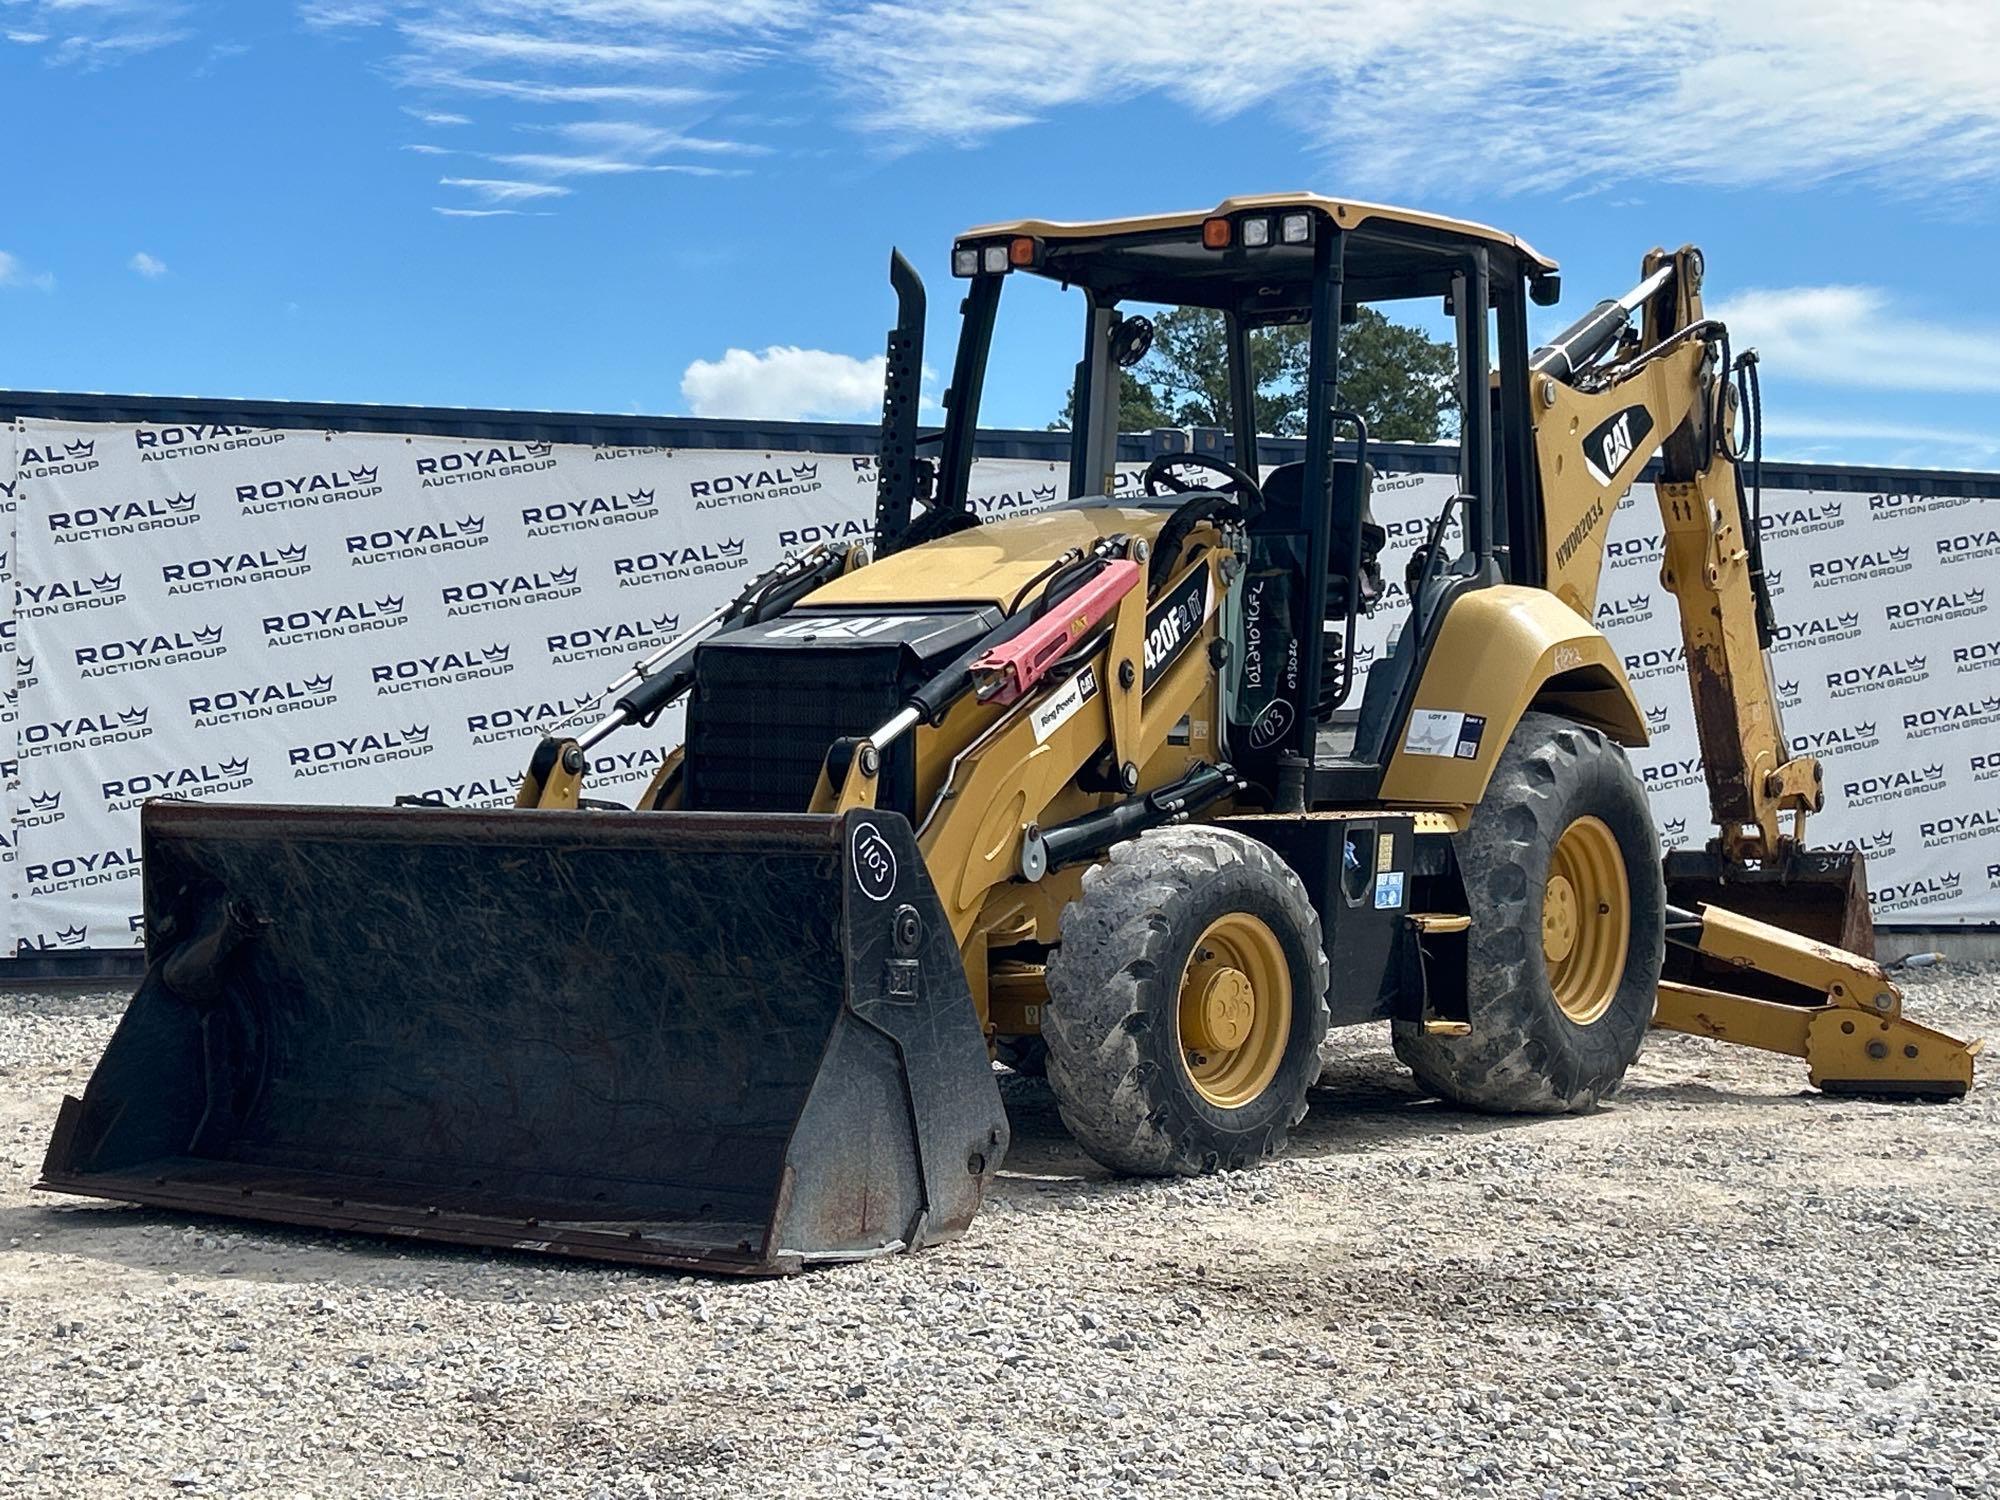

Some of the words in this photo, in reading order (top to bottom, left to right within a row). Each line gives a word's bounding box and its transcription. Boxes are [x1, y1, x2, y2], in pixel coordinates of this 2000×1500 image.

[141, 443, 220, 462] AUCTION
[223, 433, 285, 450] GROUP
[1603, 412, 1632, 474] CAT
[35, 460, 100, 478] GROUP
[416, 446, 526, 474] ROYAL
[421, 468, 496, 488] AUCTION
[500, 459, 557, 477] GROUP
[235, 472, 350, 503] ROYAL
[690, 468, 793, 498] ROYAL
[695, 491, 764, 510] AUCTION
[768, 482, 822, 499] GROUP
[1377, 477, 1424, 492] GROUP
[48, 499, 166, 531] ROYAL
[241, 497, 319, 516] AUCTION
[322, 486, 383, 504] GROUP
[522, 495, 628, 525] ROYAL
[1872, 506, 1926, 521] AUCTION
[54, 525, 134, 544] AUCTION
[138, 514, 200, 532] GROUP
[527, 518, 599, 538] AUCTION
[602, 508, 659, 526] GROUP
[1759, 508, 1821, 530] OYAL
[1761, 528, 1799, 542] CTION
[1801, 519, 1845, 534] GROUP
[346, 523, 457, 553] ROYAL
[351, 545, 426, 567] AUCTION
[430, 536, 489, 554] GROUP
[1936, 531, 2000, 555] ROYA
[162, 551, 278, 582] ROYAL
[614, 545, 718, 575] ROYAL
[1809, 552, 1890, 578] ROYAL
[1940, 549, 1993, 565] AUCTION
[167, 575, 247, 596] AUCTION
[250, 564, 312, 582] GROUP
[619, 568, 690, 588] AUCTION
[693, 559, 748, 576] GROUP
[1813, 571, 1868, 589] AUCTION
[1869, 563, 1913, 578] GROUP
[15, 580, 92, 605] YAL
[442, 573, 551, 604] ROYAL
[447, 597, 522, 618] AUCTION
[524, 586, 582, 604] GROUP
[16, 605, 59, 619] TION
[62, 594, 127, 613] GROUP
[262, 602, 377, 635] ROYAL
[1608, 612, 1652, 628] GROUP
[1885, 594, 1965, 620] ROYAL
[1889, 613, 1943, 631] AUCTION
[1945, 605, 1989, 620] GROUP
[267, 626, 345, 648] AUCTION
[348, 616, 408, 634] GROUP
[547, 621, 653, 652] ROYAL
[765, 616, 927, 637] CAT
[1776, 618, 1838, 641] OYAL
[1818, 629, 1862, 645] GROUP
[75, 632, 193, 666] ROYAL
[80, 657, 161, 679] AUCTION
[164, 646, 227, 664] GROUP
[552, 645, 624, 665] AUCTION
[1953, 642, 2000, 663] ROY
[372, 651, 483, 683] ROYAL
[377, 675, 452, 696] AUCTION
[455, 664, 514, 681] GROUP
[1627, 664, 1685, 681] AUCTION
[1826, 661, 1907, 688] ROYAL
[1957, 658, 2000, 674] AUCTIO
[189, 682, 304, 715] ROYAL
[1830, 680, 1885, 699] AUCTION
[1887, 672, 1930, 688] GROUP
[194, 707, 273, 728] AUCTION
[277, 695, 337, 714] GROUP
[467, 700, 575, 732] ROYAL
[1903, 702, 1982, 729] ROYAL
[17, 714, 119, 745] OYAL
[1253, 709, 1285, 744] 1103
[1786, 728, 1856, 751] OYAL
[1906, 722, 1960, 740] AUCTION
[17, 740, 85, 759] UCTION
[90, 727, 153, 747] GROUP
[289, 732, 401, 765] ROYAL
[1836, 739, 1880, 754] GROUP
[294, 757, 370, 779] AUCTION
[375, 745, 433, 762] GROUP
[102, 765, 220, 799] ROYAL
[191, 779, 253, 797] GROUP
[423, 778, 507, 802] OYAL
[1646, 775, 1703, 792] AUCTION
[1844, 770, 1923, 798] ROYAL
[1848, 792, 1902, 808] AUCTION
[1904, 781, 1947, 796] GROUP
[1920, 810, 1999, 837] ROYAL
[1923, 831, 1977, 848] AUCTION
[859, 837, 889, 883] 1103
[31, 873, 112, 896] AUCTION
[1873, 899, 1918, 915] UCTION
[1921, 889, 1963, 905] GROUP
